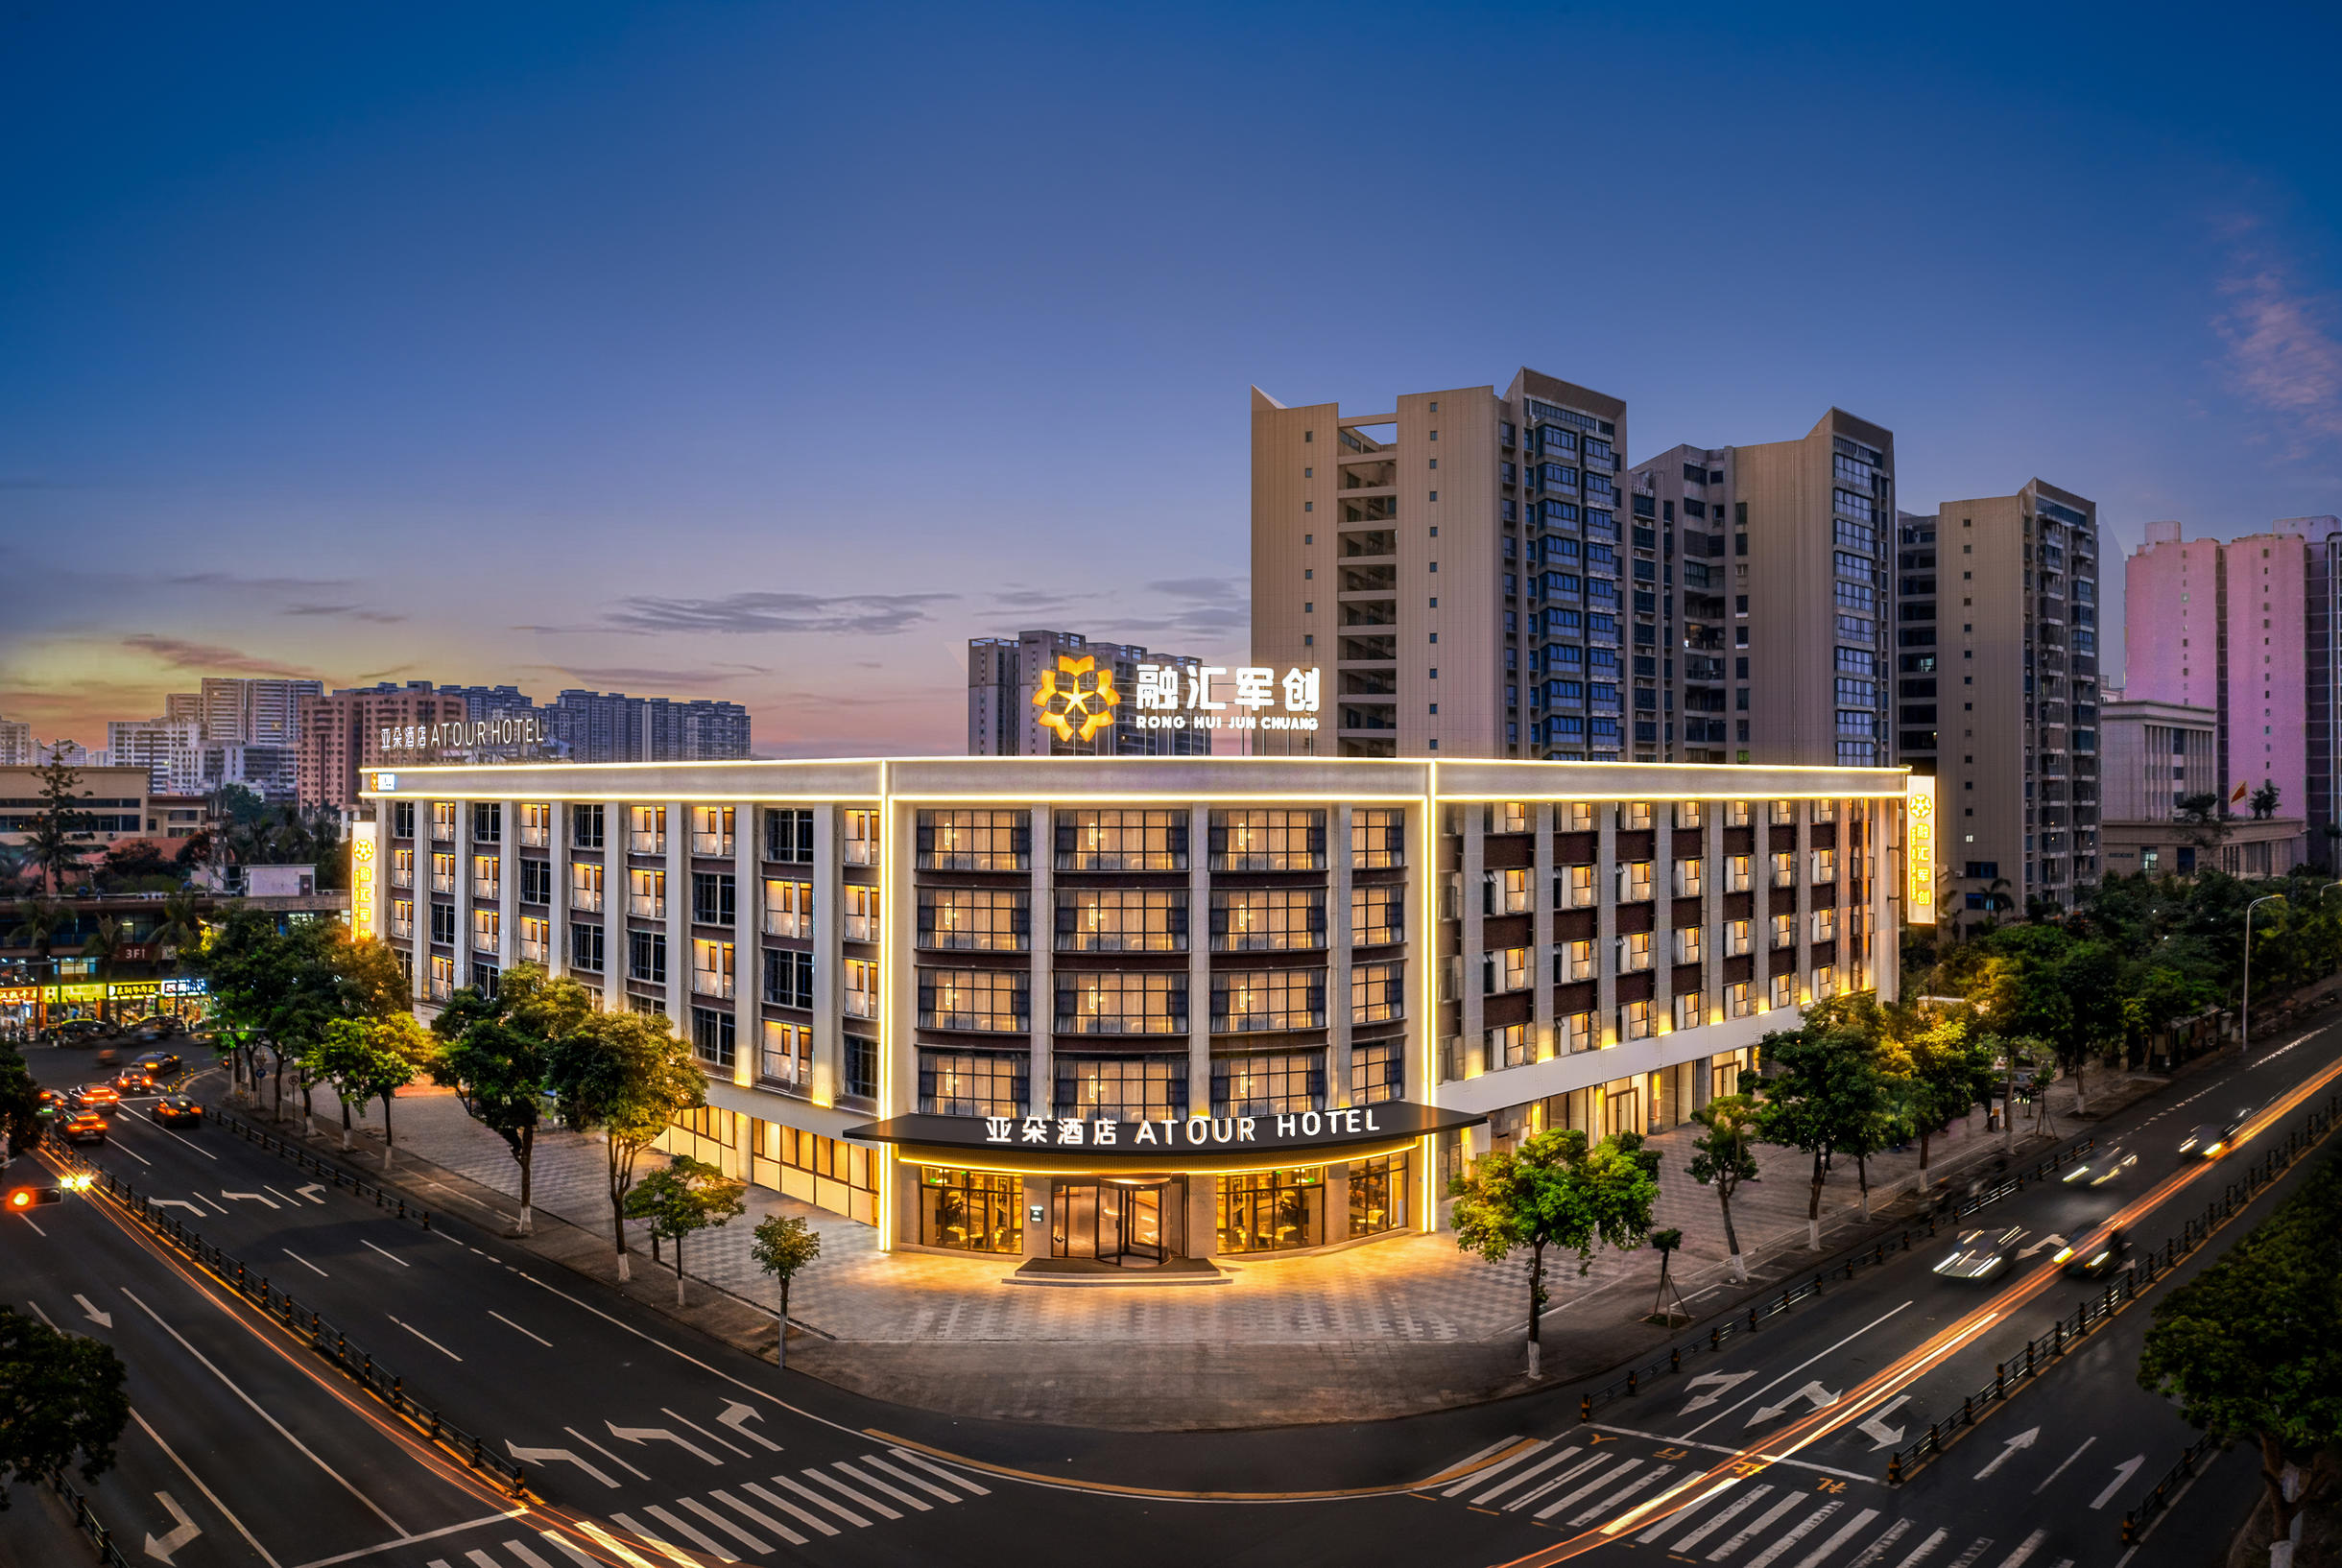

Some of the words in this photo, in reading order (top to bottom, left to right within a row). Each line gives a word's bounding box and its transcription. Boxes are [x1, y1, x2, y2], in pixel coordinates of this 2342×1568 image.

[1135, 664, 1321, 712] 融汇军创
[381, 724, 427, 750] 亚朵酒店
[431, 721, 486, 747] ATOUR
[491, 718, 544, 745] HOTEL
[1135, 715, 1185, 729] RONG
[1193, 716, 1222, 729] HUI
[1228, 716, 1256, 729] JUN
[1260, 716, 1319, 731] CHUANG
[986, 1116, 1118, 1145] 亚朵酒店
[1134, 1116, 1255, 1146] ATOUR
[1277, 1108, 1380, 1138] HOTEL
